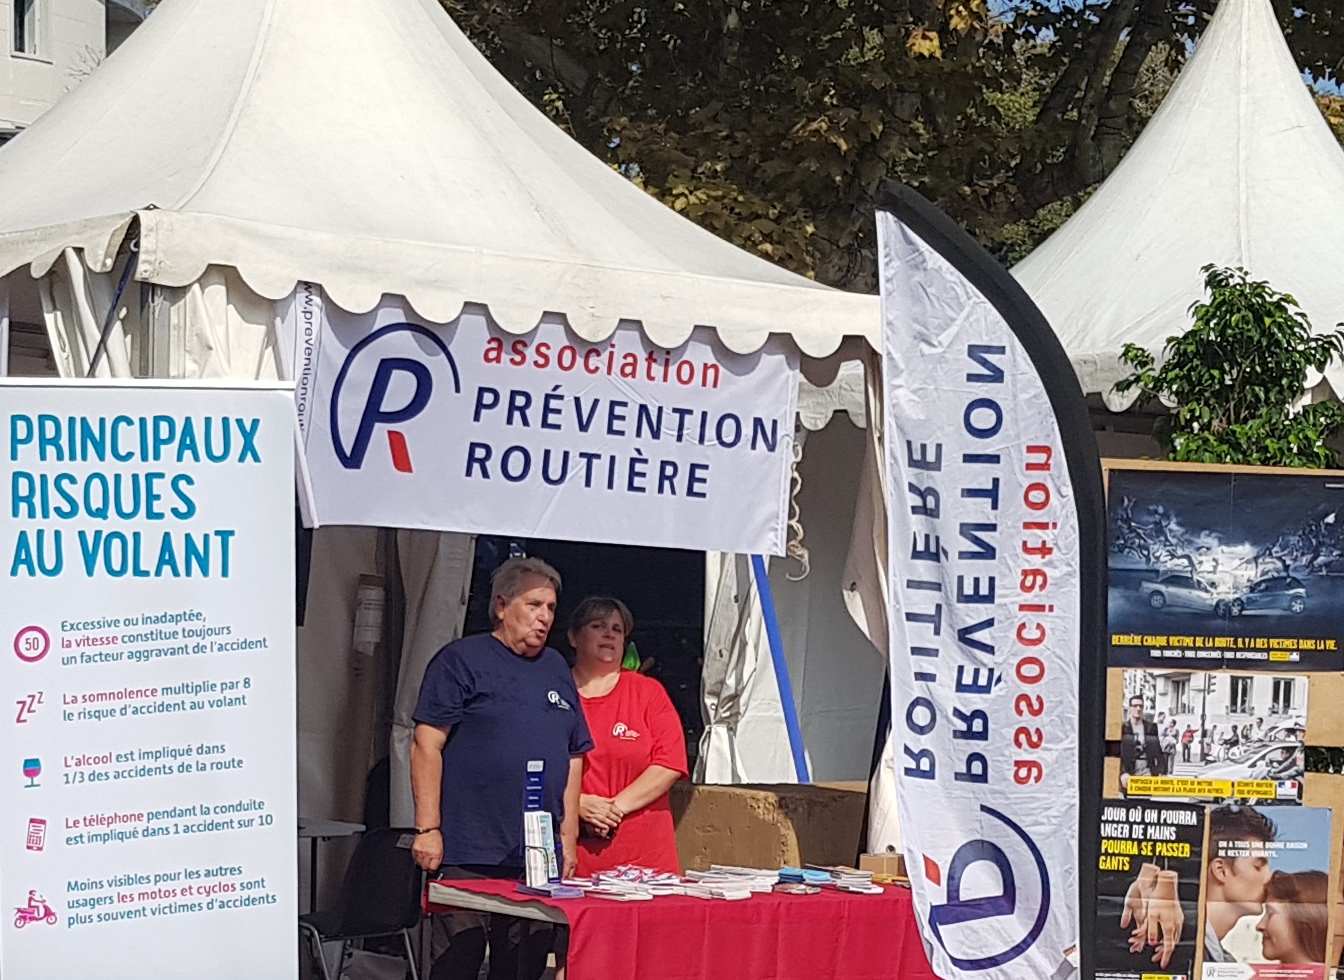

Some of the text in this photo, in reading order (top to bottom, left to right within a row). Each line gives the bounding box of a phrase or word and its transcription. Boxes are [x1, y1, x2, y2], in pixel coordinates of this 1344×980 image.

[483, 336, 721, 389] association
[473, 385, 779, 453] PRÉVENTION
[10, 414, 261, 463] PRINCIPAUX
[465, 441, 710, 499] ROUTIÈRE
[12, 472, 196, 520] RISQUES
[10, 529, 235, 578] AU VOLANT
[62, 610, 206, 632] Excessive ou inadaptée,
[25, 637, 40, 651] 50
[62, 624, 232, 649] la vitesse constitue toujours
[62, 637, 268, 666] un facteur aggravant de l'accident
[63, 677, 250, 705] La somnolence multiplie par 8
[63, 695, 247, 722] le risque d'accident au volant
[64, 742, 226, 768] L'alcool est impliqué dans
[64, 757, 244, 784] 1/3 des accidents de la route
[65, 799, 264, 829] Le téléphone pendant la conduite
[1102, 806, 1197, 825] JOUR OÙ ON POURRA
[66, 814, 272, 845] est impliqué dans 1 accident sur 10
[1132, 826, 1145, 840] DE
[1147, 826, 1176, 840] MAINS
[1101, 840, 1190, 858] POURRA SE PASSER
[1099, 856, 1130, 871] GANTS
[67, 864, 242, 892] Moins visibles pour les autres
[68, 878, 266, 910] usagers les motos et cyclos sont
[68, 893, 276, 928] plus souvent victimes d'accidents
